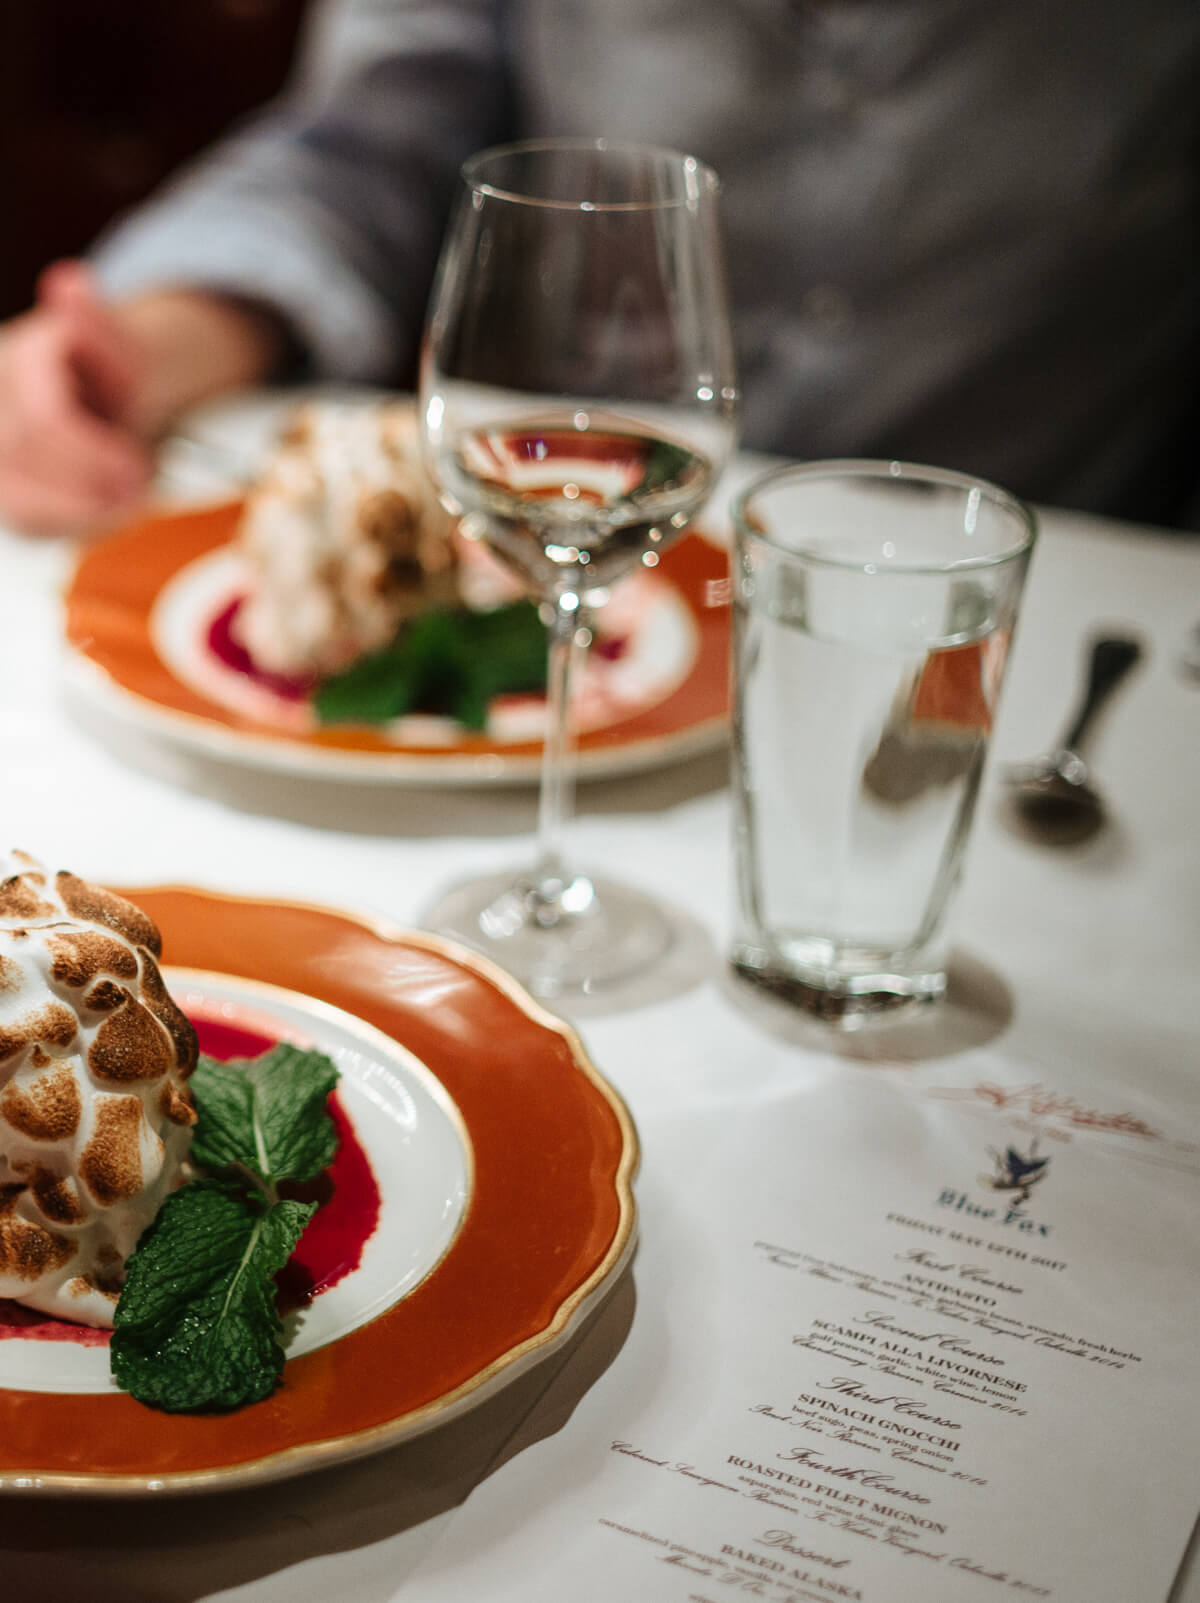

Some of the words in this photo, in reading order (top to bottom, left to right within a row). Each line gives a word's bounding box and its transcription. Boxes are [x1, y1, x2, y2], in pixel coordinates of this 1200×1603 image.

[894, 1250, 955, 1272] First
[958, 1264, 1023, 1294] Course
[902, 1273, 996, 1306] ANTIPASTO
[812, 1319, 876, 1344] SCAMPI
[879, 1341, 922, 1360] ALLA
[927, 1355, 1027, 1392] LIVORNESE
[852, 1310, 942, 1346] Second
[938, 1333, 1004, 1365] Course
[1077, 1338, 1107, 1352] fresh
[1108, 1347, 1141, 1362] herbs
[792, 1335, 869, 1367] Chardonnay
[988, 1402, 1027, 1416] 2014
[806, 1332, 833, 1345] gulf
[832, 1339, 875, 1357] prawns,
[876, 1353, 911, 1369] garlic,
[915, 1365, 947, 1379] white
[949, 1376, 978, 1390] wine,
[980, 1385, 1017, 1402] lemon
[797, 1393, 875, 1423] SPINACH
[877, 1419, 960, 1451] GNOCCHI
[815, 1376, 892, 1404] Third
[893, 1396, 961, 1429] Course
[791, 1404, 819, 1417] beef
[817, 1415, 847, 1428] sugo,
[847, 1424, 878, 1439] peas,
[880, 1435, 919, 1452] spring
[920, 1448, 954, 1462] onion
[727, 1455, 812, 1488] ROASTED
[813, 1484, 868, 1507] FILET
[871, 1502, 947, 1534] MIGNON
[737, 1475, 798, 1500] asparagus,
[800, 1496, 823, 1507] red
[823, 1503, 853, 1517] wine
[776, 1447, 864, 1483] Fourth
[860, 1469, 931, 1504] Course
[947, 1471, 988, 1485] 2014
[720, 1544, 785, 1572] BAKED
[788, 1569, 862, 1600] ALASKA
[752, 1529, 851, 1568] Dessert
